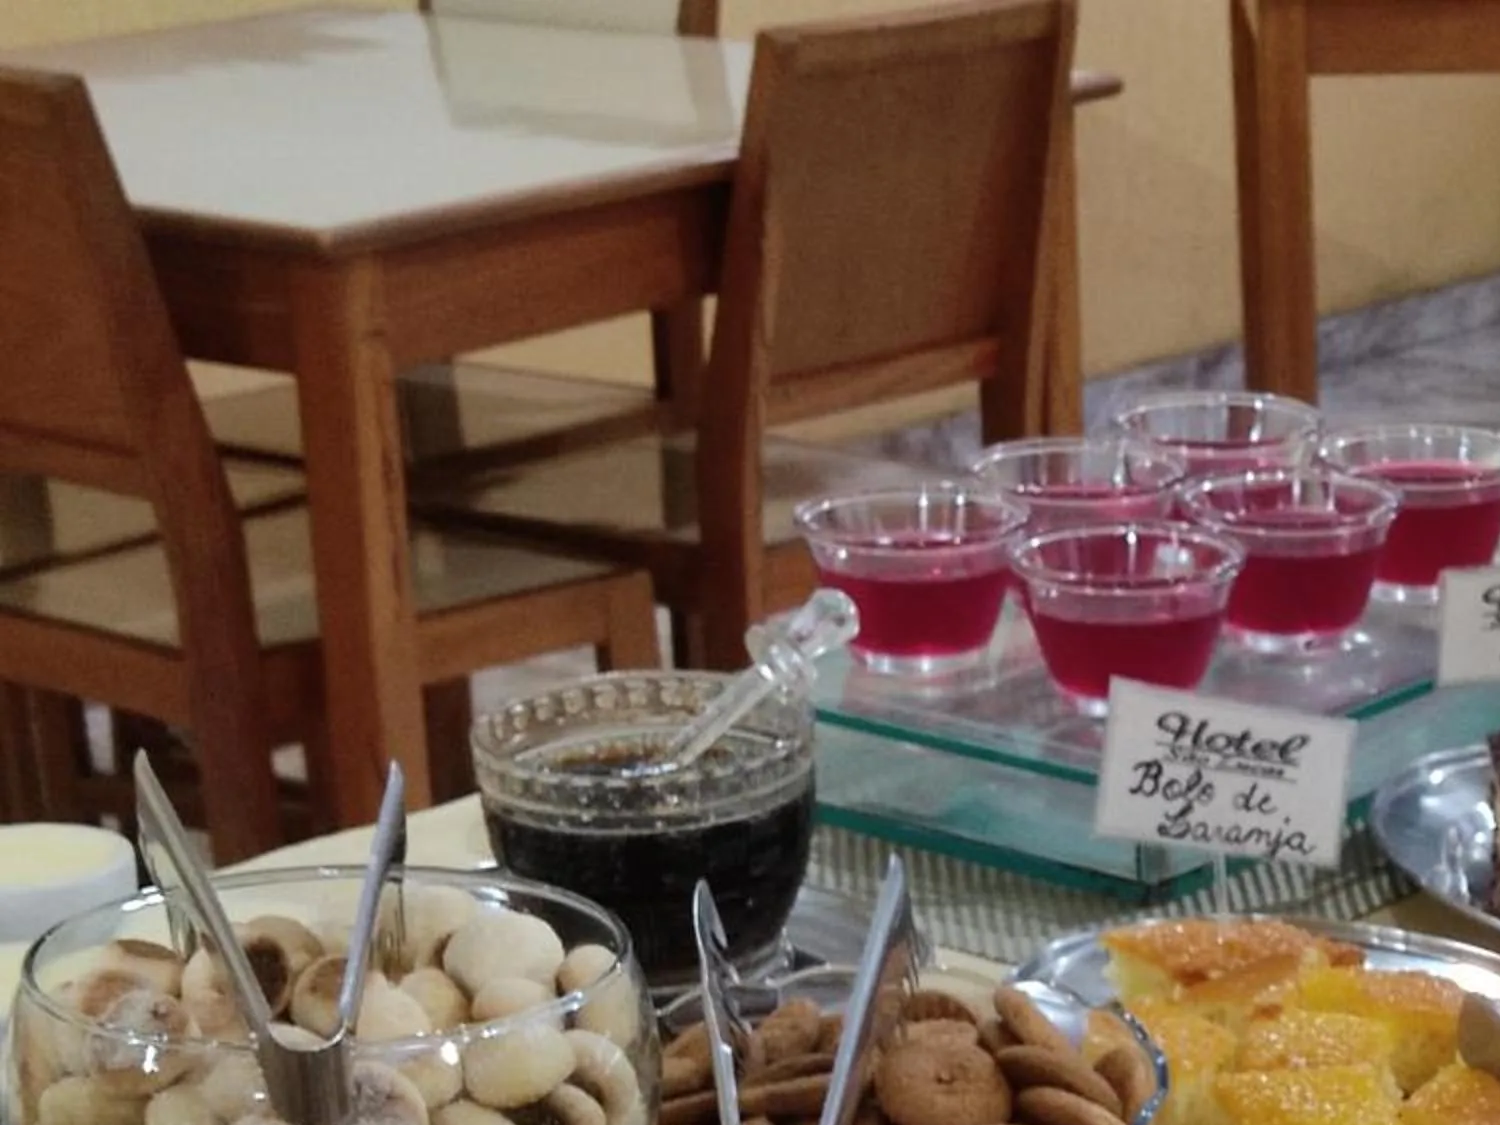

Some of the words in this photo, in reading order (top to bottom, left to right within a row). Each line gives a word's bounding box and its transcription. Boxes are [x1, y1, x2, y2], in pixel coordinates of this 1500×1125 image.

[1156, 711, 1311, 761] Hotel
[1129, 759, 1216, 802] Bolo
[1233, 782, 1279, 815] de
[1156, 801, 1317, 858] Laranja
